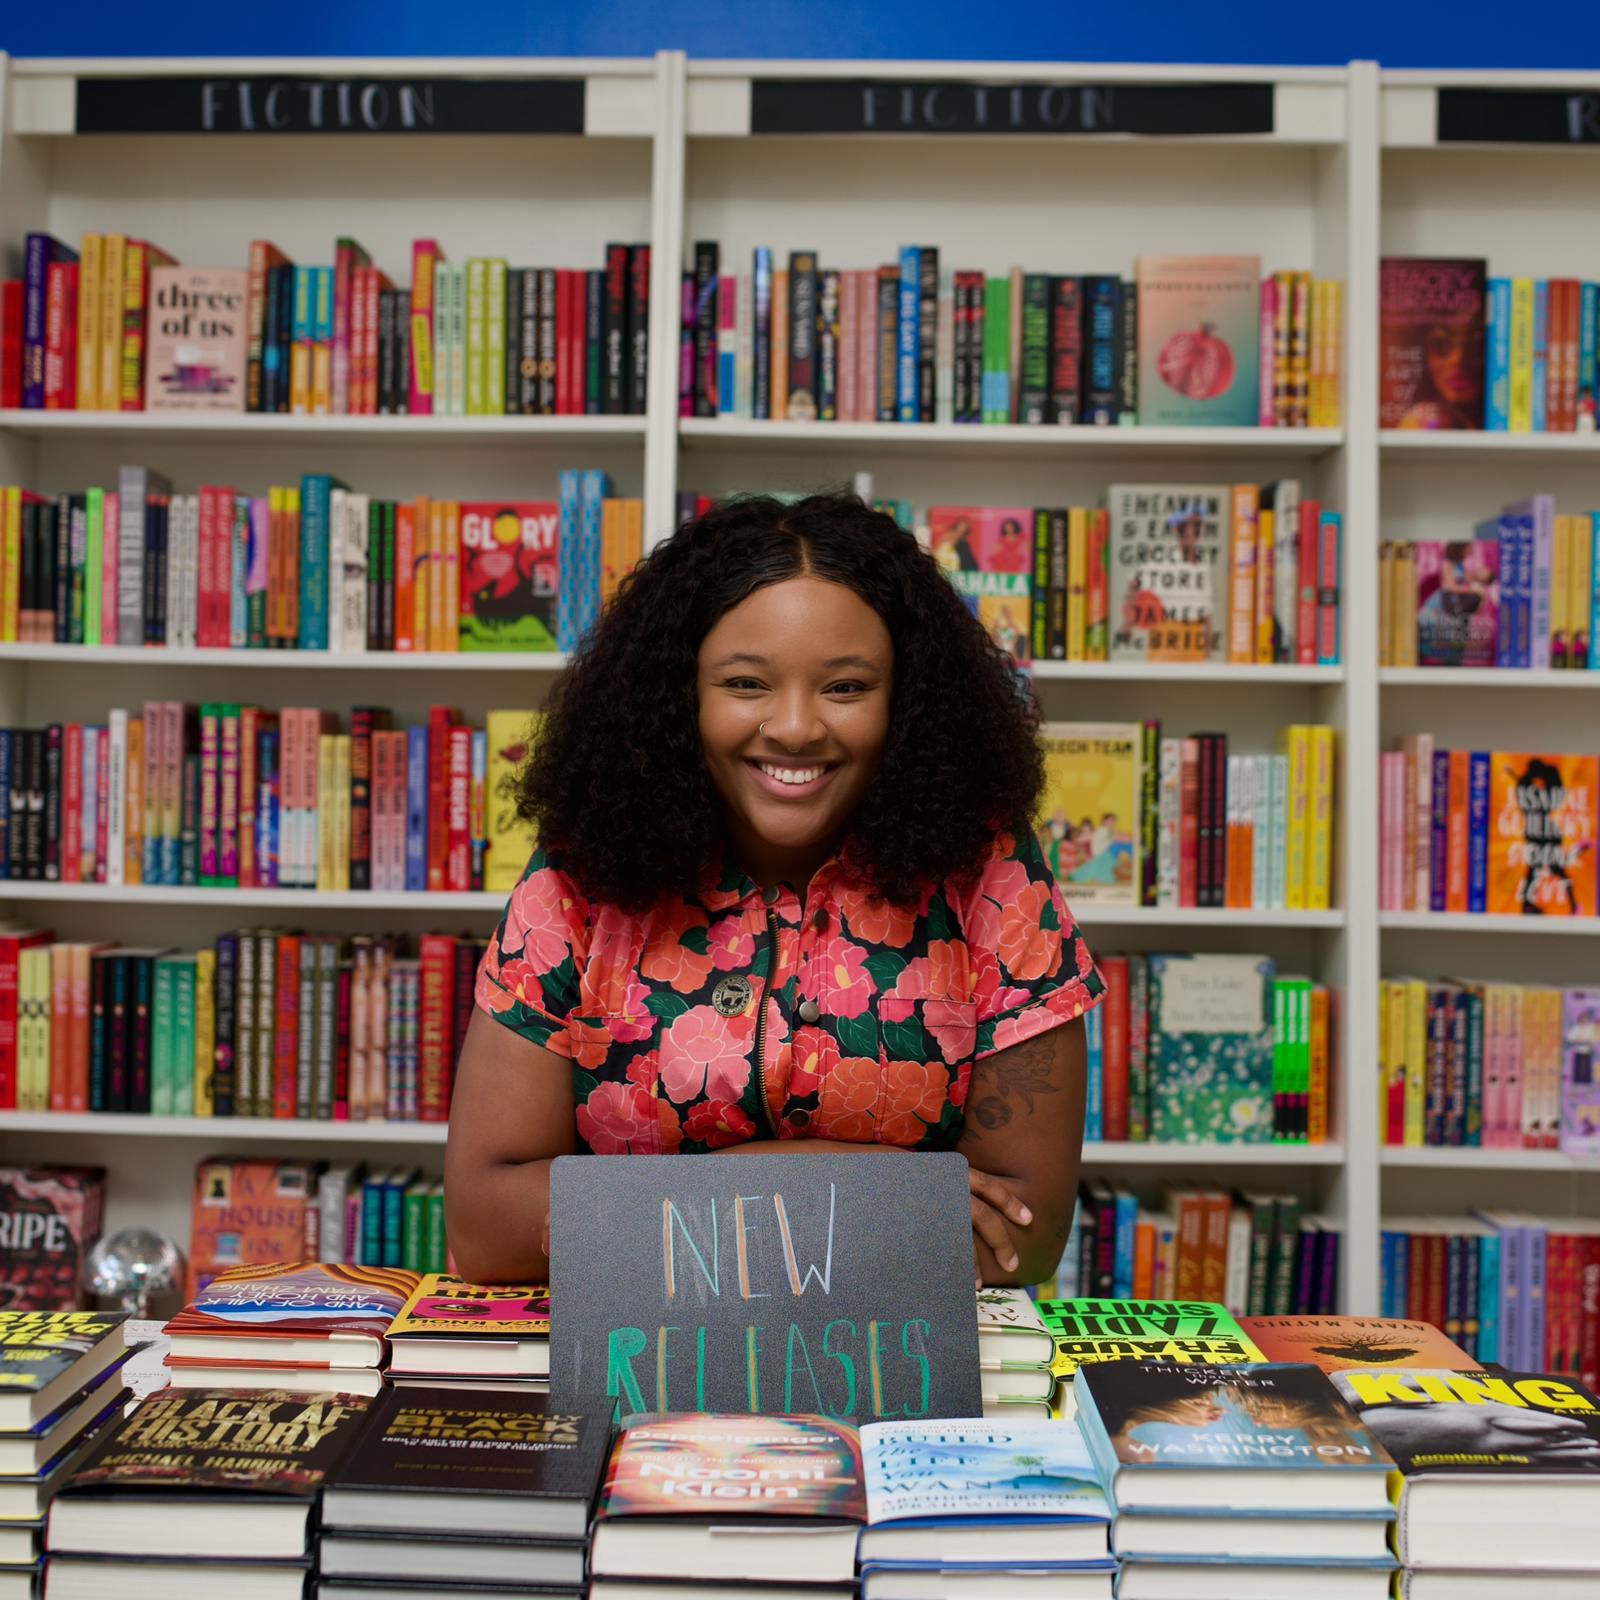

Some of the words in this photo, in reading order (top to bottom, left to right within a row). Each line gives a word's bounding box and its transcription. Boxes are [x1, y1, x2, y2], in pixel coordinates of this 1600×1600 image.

[202, 82, 435, 130] FICTION
[863, 87, 1114, 128] FICTION
[157, 283, 242, 314] three
[162, 312, 193, 337] of
[200, 319, 234, 337] us
[1135, 494, 1219, 515] HEAVEN
[462, 511, 558, 550] GLORY
[1119, 546, 1219, 567] GROCERY
[1135, 571, 1205, 589] STORE
[1133, 605, 1207, 624] JAMES
[1045, 740, 1089, 754] EECH
[1094, 740, 1132, 754] TEAM
[219, 1207, 298, 1229] HOUSE
[0, 1211, 68, 1252] RIPE
[663, 1183, 836, 1301] NEW
[218, 1284, 293, 1293] ZHANG
[230, 1291, 320, 1300] HONEY
[302, 1285, 354, 1295] PAM
[427, 1289, 549, 1299] IGHT
[206, 1297, 266, 1308] MILK
[272, 1299, 310, 1308] OF
[326, 1293, 371, 1302] AND
[326, 1301, 385, 1312] LAND
[1040, 1301, 1217, 1317] SMITH
[0, 1312, 97, 1323] SLIE
[1252, 1319, 1342, 1328] MATHIS
[1052, 1316, 1234, 1338] ZADIE
[1354, 1321, 1426, 1332] AYANA
[1058, 1340, 1248, 1355] FRAUD
[607, 1319, 932, 1424] RELEASES
[1138, 1365, 1251, 1378] THICKER
[1185, 1376, 1277, 1387] WATER
[1345, 1373, 1597, 1410] KING
[132, 1397, 288, 1423] BLACK
[288, 1400, 370, 1427] AF
[398, 1407, 584, 1422] HISTORICALLY
[392, 1414, 579, 1434] BLACK
[115, 1418, 339, 1449] HISTORY
[384, 1426, 579, 1444] PHRASES
[628, 1431, 841, 1444] Doppelganger
[879, 1435, 1013, 1446] BUILD
[1192, 1433, 1297, 1446] KERRY
[1128, 1443, 1373, 1458] WASHINGTON
[99, 1452, 195, 1468] MICHAEL
[203, 1456, 304, 1473] HARRIOT
[1410, 1453, 1498, 1467] Jonathan
[639, 1462, 826, 1480] Naomi
[661, 1479, 800, 1499] Klein
